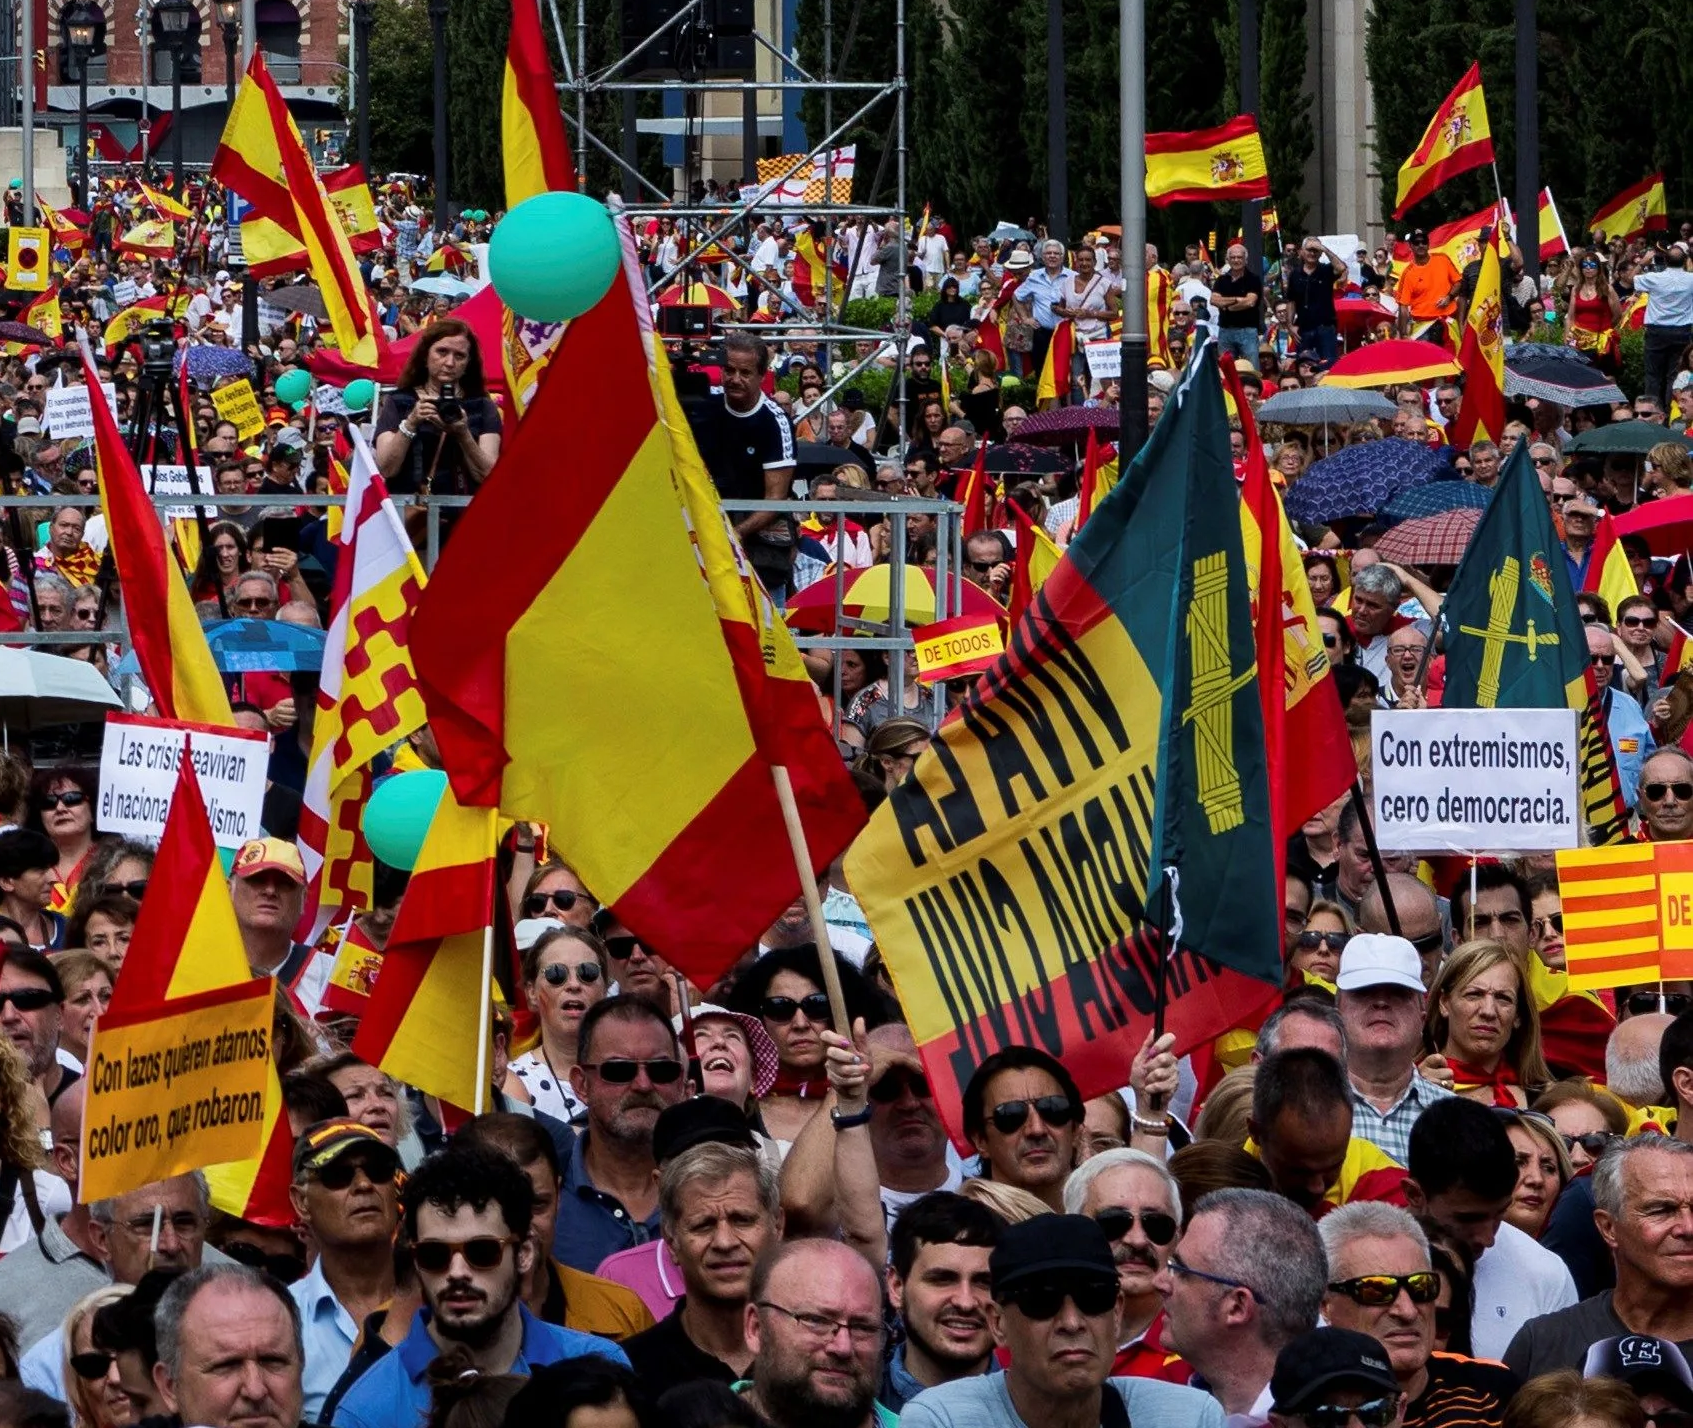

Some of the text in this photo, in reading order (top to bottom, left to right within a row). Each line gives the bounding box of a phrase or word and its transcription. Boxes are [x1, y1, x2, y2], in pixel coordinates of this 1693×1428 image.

[924, 633, 995, 664] DE TODOS.
[119, 732, 143, 767] Las
[1380, 730, 1571, 776] Con extremismos,
[102, 784, 114, 818] el
[1381, 787, 1571, 825] cero democracia.
[1668, 895, 1692, 926] DE
[93, 1026, 271, 1095] Con lazos quieren atarnos,
[89, 1086, 265, 1161] color oro, que robaron.
